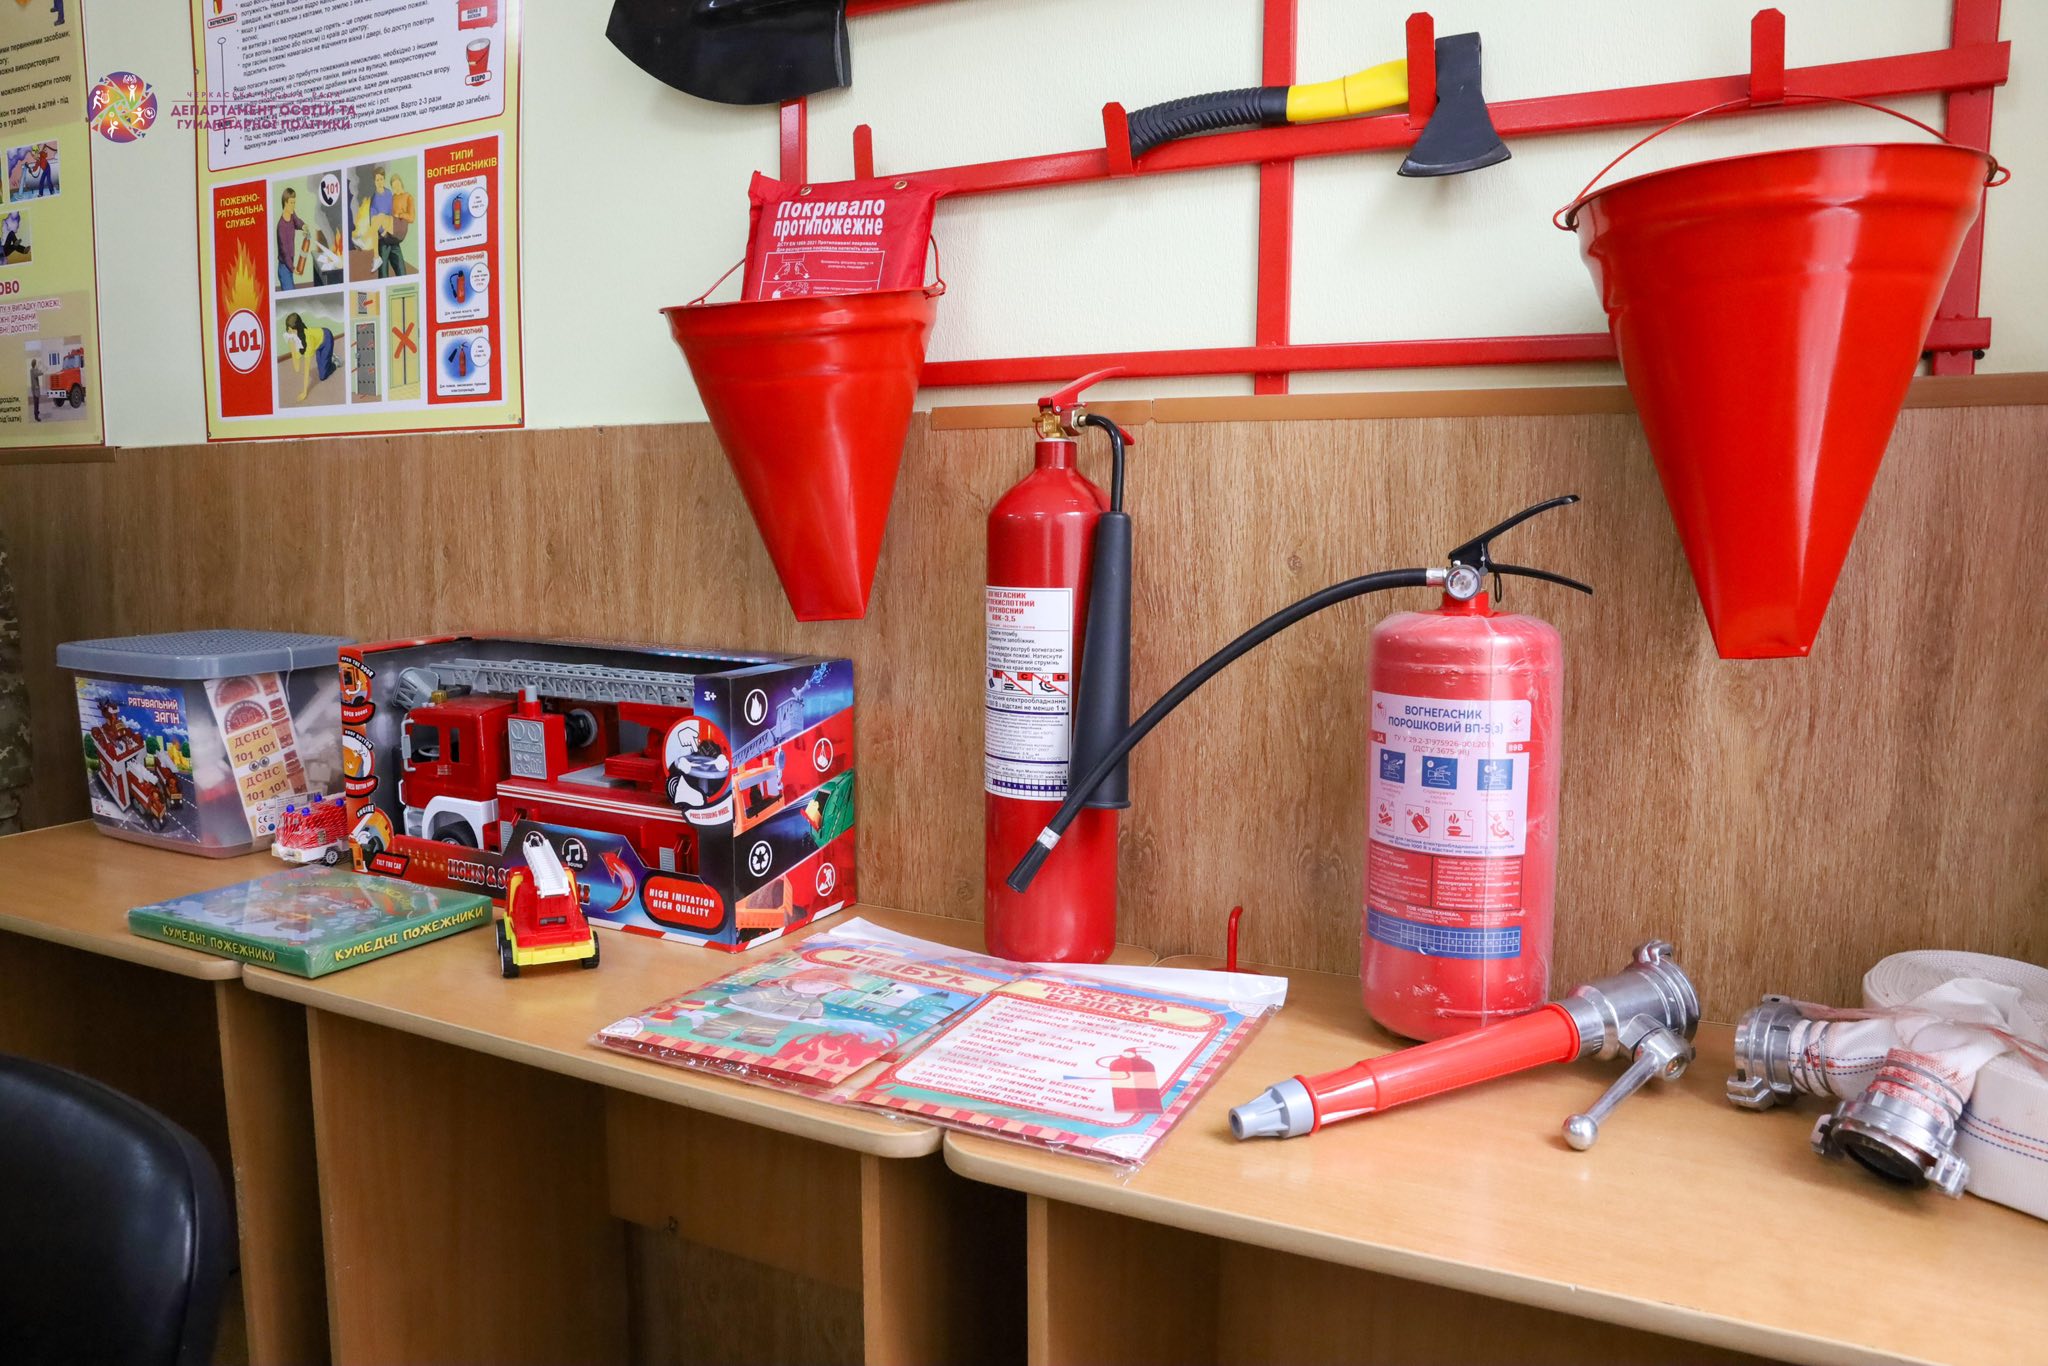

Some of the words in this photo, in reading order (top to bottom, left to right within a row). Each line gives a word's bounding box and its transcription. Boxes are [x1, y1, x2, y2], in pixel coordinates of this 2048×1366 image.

[471, 74, 486, 83] ВІДРО
[449, 148, 474, 161] ТИПИ
[427, 157, 497, 178] ВОГНЕГАСНИКІВ
[326, 181, 339, 195] 101
[443, 178, 477, 190] ПОРОШКОВИЙ
[220, 193, 260, 207] ПОЖЕЖНО-
[216, 205, 264, 219] РЯТУВАЛЬНА
[777, 199, 886, 221] Покривало
[225, 217, 256, 229] СЛУЖБА
[773, 216, 884, 241] протипожежне
[438, 252, 485, 265] ПОВІТРЯНО-ПІННИЙ
[228, 328, 261, 354] 101
[360, 664, 374, 677] DOOR
[128, 697, 178, 710] РЯТУВАЛЬНИЙ
[703, 691, 717, 701] 3+
[1006, 696, 1067, 704] електрообладнання
[154, 711, 180, 724] ЗАГІН
[233, 712, 257, 727] 101
[1404, 705, 1482, 720] ВОГНЕГАСНИК
[1388, 716, 1461, 733] ПОРОШКОВИЙ
[234, 726, 270, 749] ДСНС
[235, 750, 254, 763] 101
[258, 741, 276, 755] 101
[246, 766, 281, 788] ДСНС
[246, 788, 265, 802] 101
[269, 780, 287, 794] 101
[357, 804, 374, 818] ENGINE
[1425, 806, 1430, 814] B
[486, 865, 497, 888] &
[649, 888, 669, 900] HIGH
[672, 892, 715, 908] IMITATION
[653, 900, 672, 910] HIGH
[675, 903, 710, 918] QUALITY
[335, 932, 399, 962] КУМЕДНІ
[403, 906, 484, 941] ПОЖЕЖНИКИ
[162, 924, 207, 946] КУМЕДНІ
[210, 936, 276, 963] ПОЖЕЖНИКИ
[1043, 985, 1169, 1014] ПОЖЕЖНА
[1044, 993, 1150, 1018] БЕЗПЕКА
[990, 1015, 1014, 1024] КОЮ
[1079, 1014, 1116, 1024] ВОГОНЬ
[982, 1020, 1047, 1038] ВІДГАДУЄМО
[1049, 1033, 1096, 1048] ЗАГАДКИ
[1072, 1019, 1121, 1032] ПОЖЕЖНІ
[1123, 1028, 1157, 1038] ЗНАКИ
[1080, 1026, 1149, 1044] ПОЖЕЖНОЮ
[960, 1039, 1014, 1054] ВИВЧАЄМО
[968, 1032, 1022, 1048] ЗАВДАННЯ
[975, 1027, 1036, 1043] ВИКОНУЄМО
[1038, 1040, 1074, 1051] ЦІКАВІ
[952, 1044, 1000, 1058] ІНВЕНТАР
[937, 1055, 984, 1070] ПРАВИЛА
[986, 1066, 1046, 1083] ПОЖЕЖНОЇ
[1048, 1078, 1097, 1094] БЕЗПЕКИ
[911, 1074, 933, 1084] ПРИ
[935, 1079, 1005, 1097] ВИНИКНЕННІ
[1003, 1092, 1046, 1107] ПОЖЕЖ
[995, 1076, 1045, 1091] ПРИЧИНИ
[1047, 1087, 1091, 1101] ПОЖЕЖ
[988, 1083, 1037, 1098] ПРАВИЛА
[1040, 1094, 1105, 1112] ПОВЕДІНКИ
